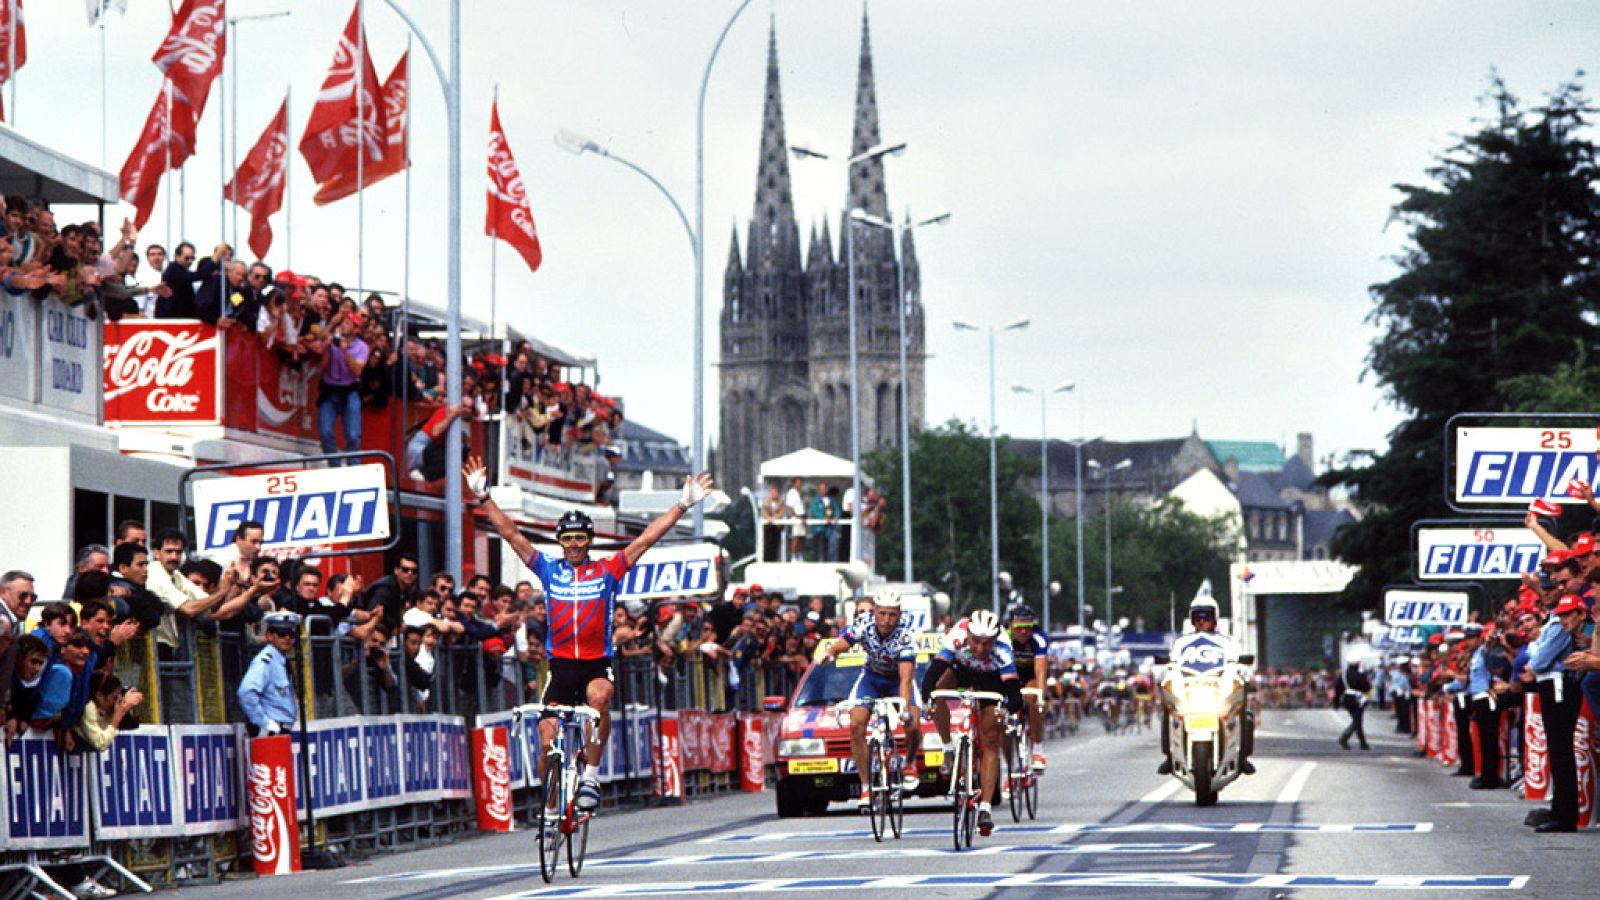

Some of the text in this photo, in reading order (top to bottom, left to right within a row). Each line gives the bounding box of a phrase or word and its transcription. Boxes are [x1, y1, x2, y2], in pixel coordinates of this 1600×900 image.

[146, 388, 200, 412] Coke
[1541, 431, 1572, 449] 25
[266, 476, 298, 495] 25
[1471, 453, 1600, 496] FIA
[211, 490, 378, 548] FIAT
[1473, 530, 1495, 543] 50
[631, 560, 710, 595] IAT
[1427, 545, 1541, 574] FIAT
[1390, 602, 1463, 622] FIAT
[185, 746, 236, 812] FIAT
[310, 737, 359, 800] FIAT
[366, 735, 397, 790] FIAT
[404, 731, 438, 784] FIAT
[9, 751, 82, 825] FIAT
[101, 747, 167, 814] FIAT
